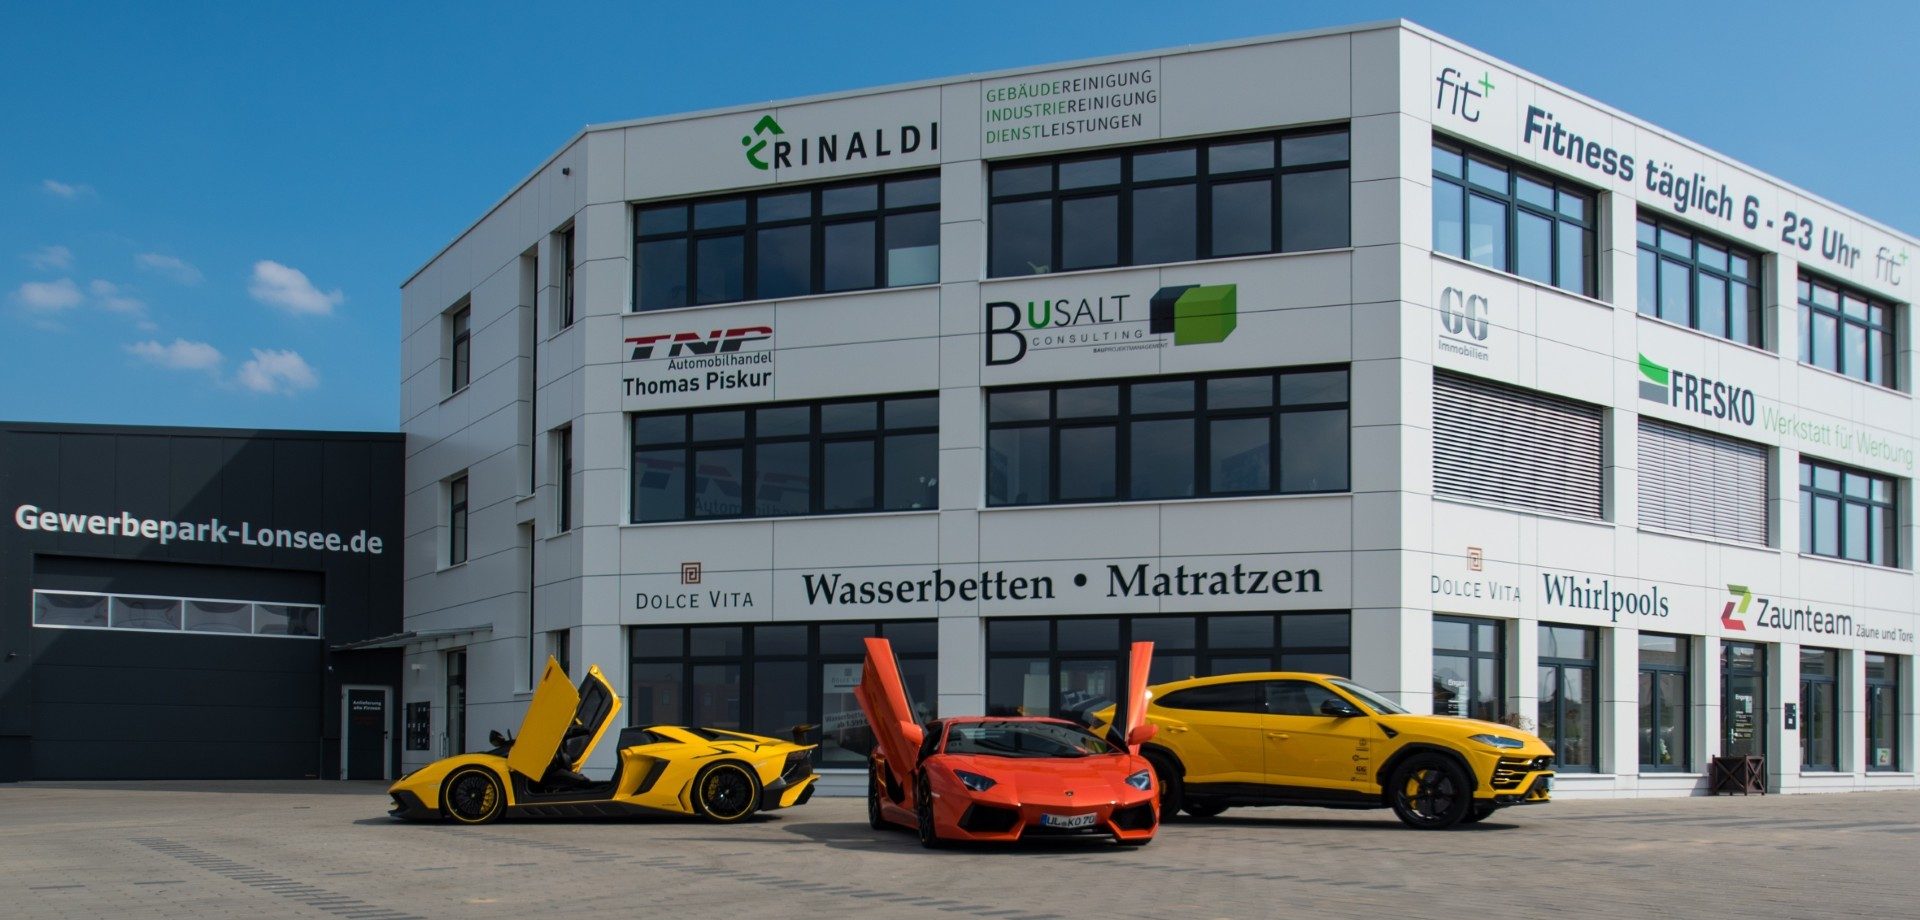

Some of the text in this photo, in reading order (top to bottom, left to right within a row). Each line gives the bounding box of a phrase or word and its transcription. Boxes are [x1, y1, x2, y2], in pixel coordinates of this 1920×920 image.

[986, 69, 1152, 103] GEBÄUDEREINIGUNG
[986, 89, 1157, 123] INDUSTRIEREINIGUNG
[774, 121, 938, 169] RINALDI
[986, 113, 1142, 144] DIENSTLEISTUNGEN
[1523, 104, 1635, 182] Fitness
[1645, 159, 1733, 221] täglich
[1743, 194, 1760, 230] 6
[1781, 210, 1814, 251] 23
[1821, 226, 1861, 269] Uhr
[985, 294, 1131, 367] BUSALT
[1439, 286, 1489, 341] GG
[624, 325, 773, 361] TNP
[1032, 329, 1144, 347] CONSULTING
[1438, 340, 1489, 361] Immobilien
[667, 351, 773, 371] Automobilhandel
[623, 369, 772, 397] Thomas Piskur
[1672, 368, 1756, 426] FRESKO
[1761, 405, 1914, 470] Werkstatt für Werbung
[15, 503, 384, 555] Gewerbepark-Lonsee.de
[635, 590, 754, 610] DOLCE VITA
[801, 567, 1056, 606] Wasserbetten
[1106, 562, 1323, 598] Matratzen
[1430, 574, 1521, 602] DOLCE VITA
[1542, 572, 1669, 623] Whirlpools
[1756, 597, 1852, 637] Zaunteam
[1855, 623, 1914, 643] Zäune und Tore
